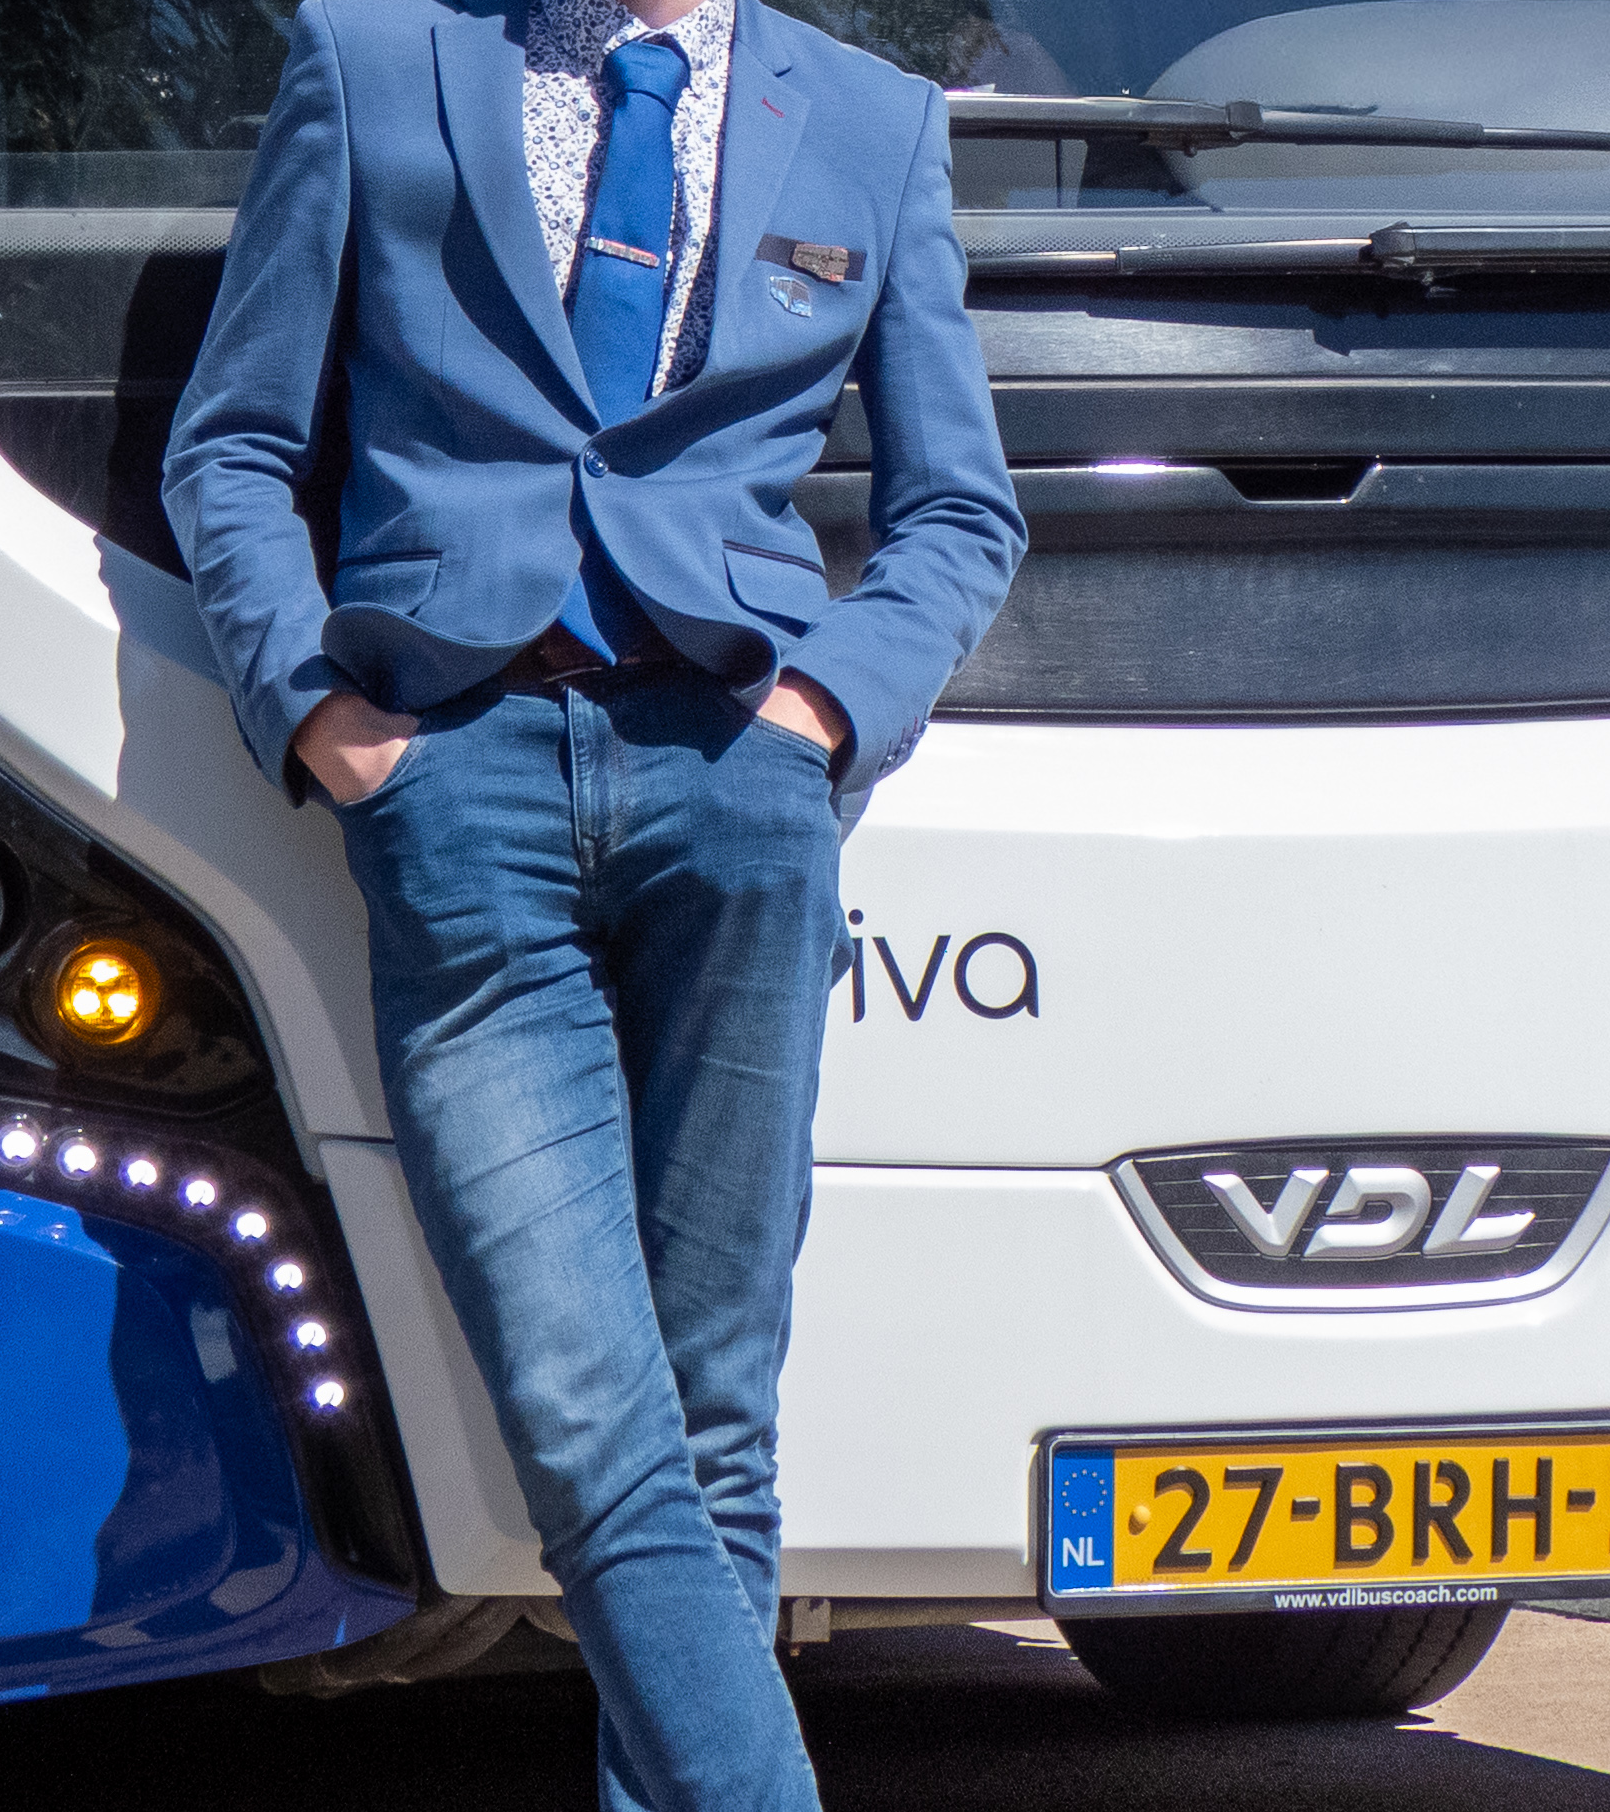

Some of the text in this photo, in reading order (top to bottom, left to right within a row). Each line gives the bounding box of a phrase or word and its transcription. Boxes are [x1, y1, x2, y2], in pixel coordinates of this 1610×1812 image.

[1201, 1163, 1536, 1259] VDL
[1061, 1537, 1105, 1568] NL
[1274, 1585, 1499, 1609] www.vdlbuscoach.com
